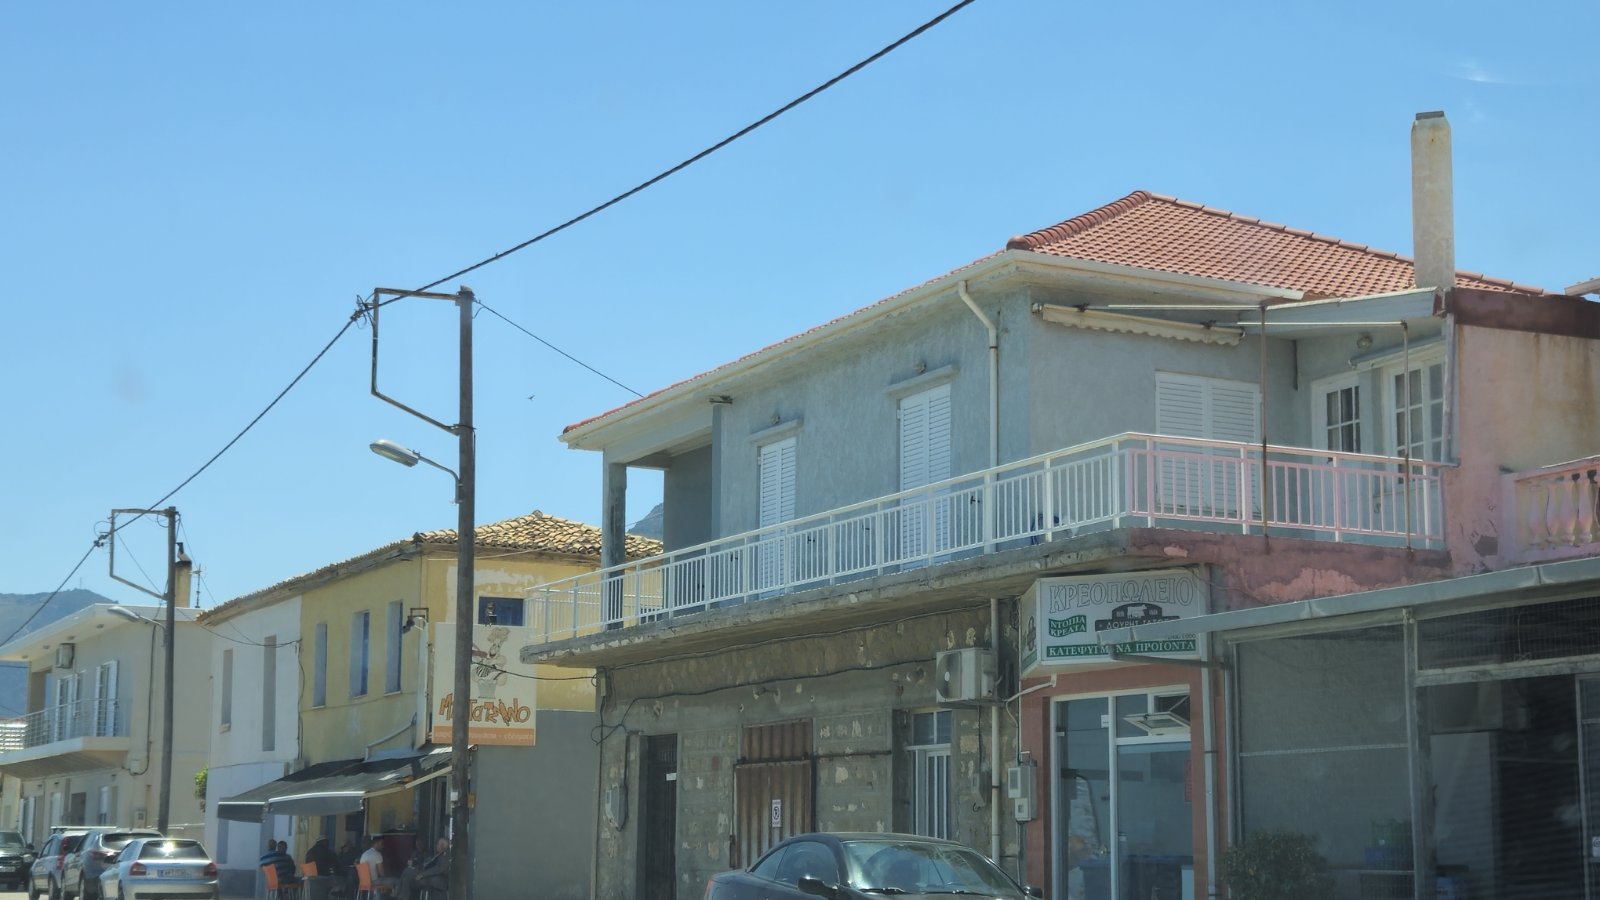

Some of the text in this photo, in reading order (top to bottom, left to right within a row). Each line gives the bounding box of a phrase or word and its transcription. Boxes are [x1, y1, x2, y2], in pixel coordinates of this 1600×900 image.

[1049, 577, 1194, 613] ΚΡΕΟΠΩΛΕΙΟ
[1050, 617, 1085, 628] ΝΤΟΠΙΑ
[1050, 625, 1085, 637] ΚΡΕΑΤΑ
[1049, 643, 1132, 656] ΚΑΤΕΨΥΓΜΝΑ
